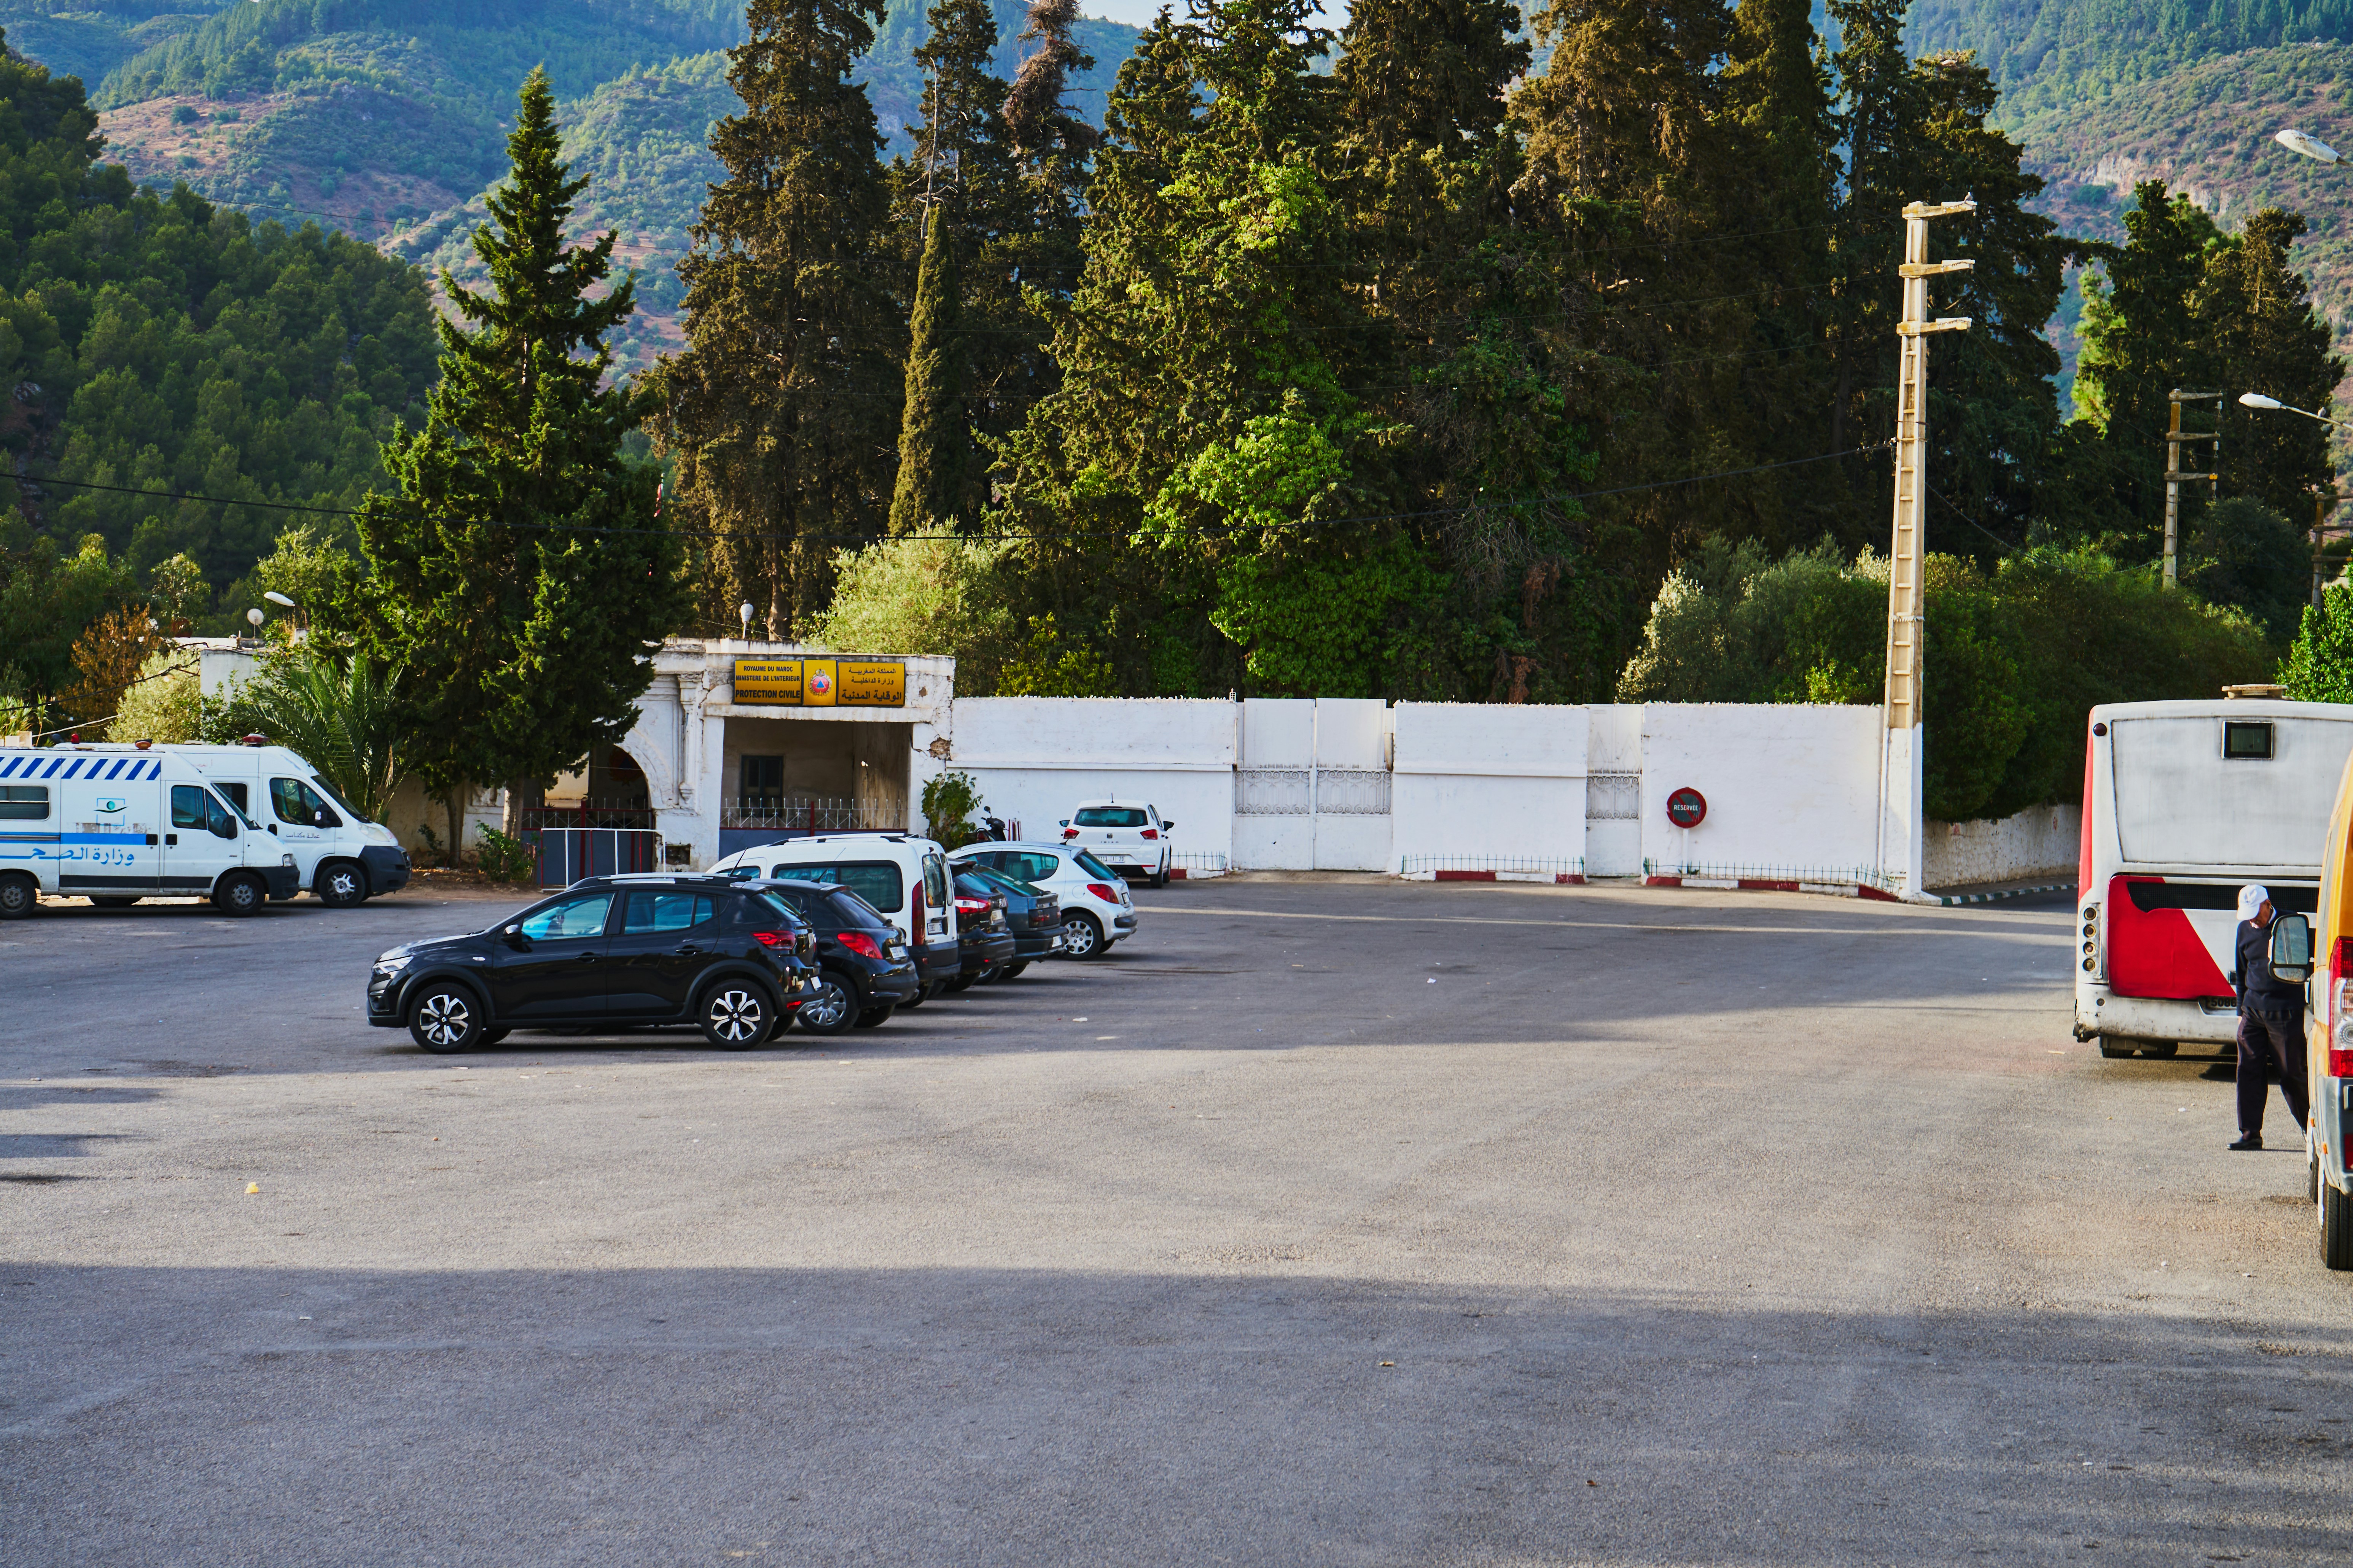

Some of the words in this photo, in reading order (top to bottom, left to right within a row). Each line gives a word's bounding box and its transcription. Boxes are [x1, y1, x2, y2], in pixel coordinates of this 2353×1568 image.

[851, 676, 877, 685] الداخلية
[736, 690, 777, 698] PROTECTION
[779, 690, 800, 698] CIVILE
[841, 689, 870, 701] المدنية
[873, 690, 902, 702] الوقاية
[0, 847, 88, 860] الصح
[92, 848, 135, 866] وزارة
